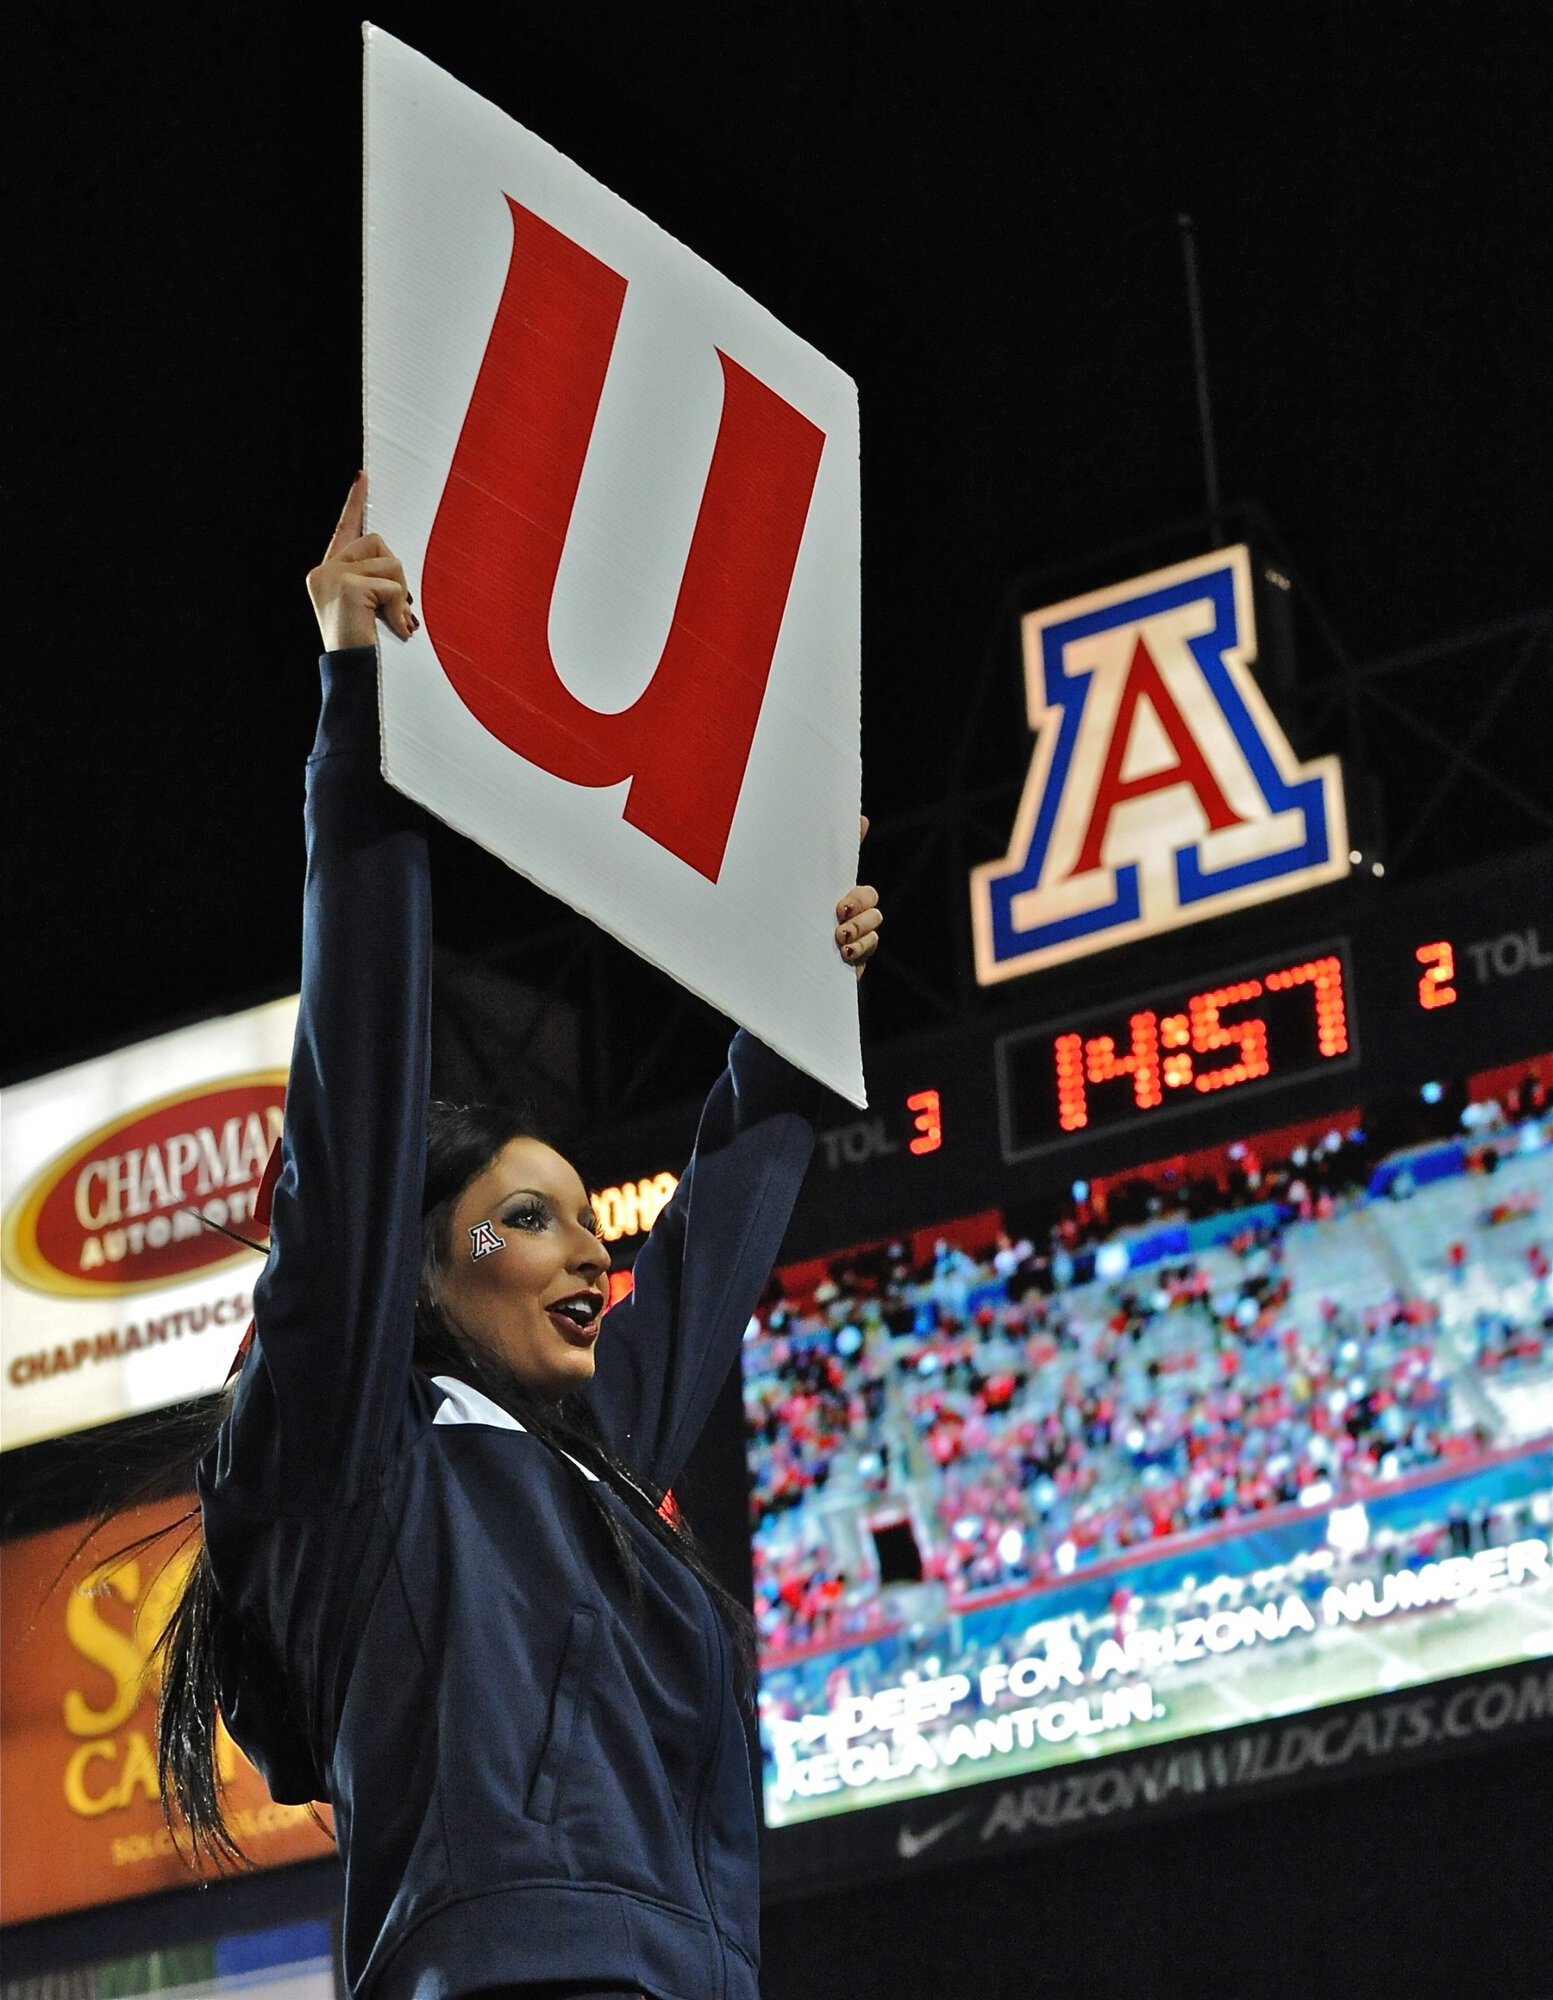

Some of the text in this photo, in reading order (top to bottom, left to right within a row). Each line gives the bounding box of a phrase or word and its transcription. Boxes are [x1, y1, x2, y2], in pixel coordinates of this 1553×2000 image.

[970, 542, 1351, 988] A
[1416, 930, 1553, 1010] 2 TOL
[1054, 955, 1349, 1132] 14:57
[822, 1090, 942, 1171] TOL 3
[468, 1220, 507, 1263] A
[980, 1643, 1082, 1705] FOR
[1092, 1602, 1315, 1682] ARIZONA
[1324, 1538, 1551, 1624] NUMBER
